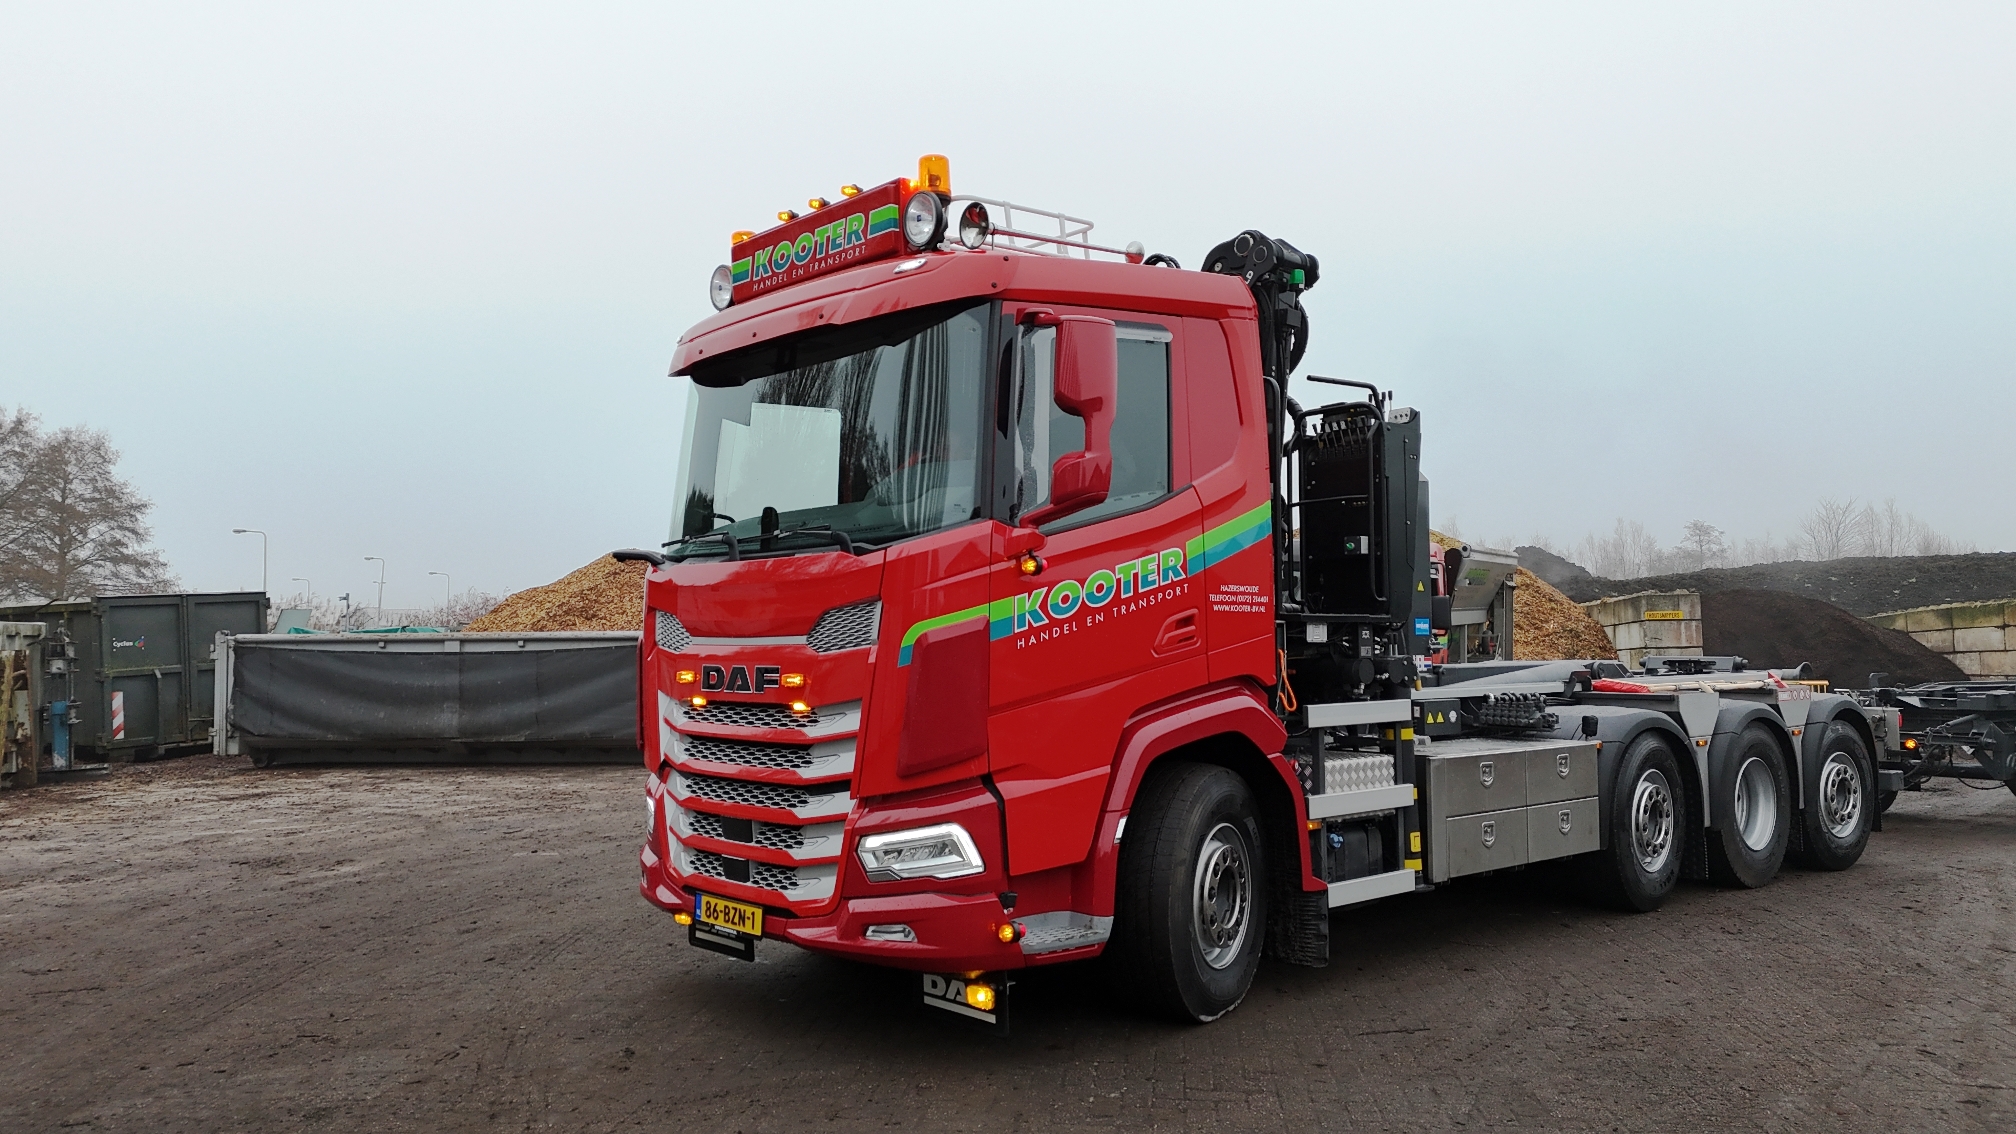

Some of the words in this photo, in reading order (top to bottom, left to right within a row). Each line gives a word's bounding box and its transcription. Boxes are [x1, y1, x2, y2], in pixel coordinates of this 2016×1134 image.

[753, 213, 866, 281] KOOTER
[753, 274, 787, 291] HANDEL
[792, 266, 804, 278] EN
[809, 245, 866, 272] TRANSPORT
[1014, 547, 1187, 633] KOOTER
[1209, 593, 1237, 602] TELEFOON
[1220, 584, 1260, 593] HAZERSWOUDE
[1017, 621, 1078, 650] HANDEL
[1086, 612, 1104, 627] EN
[1112, 583, 1189, 618] TRANSPORT
[701, 664, 781, 694] DAF
[705, 900, 756, 931] 86-BZN-1
[923, 973, 968, 1004] DA
